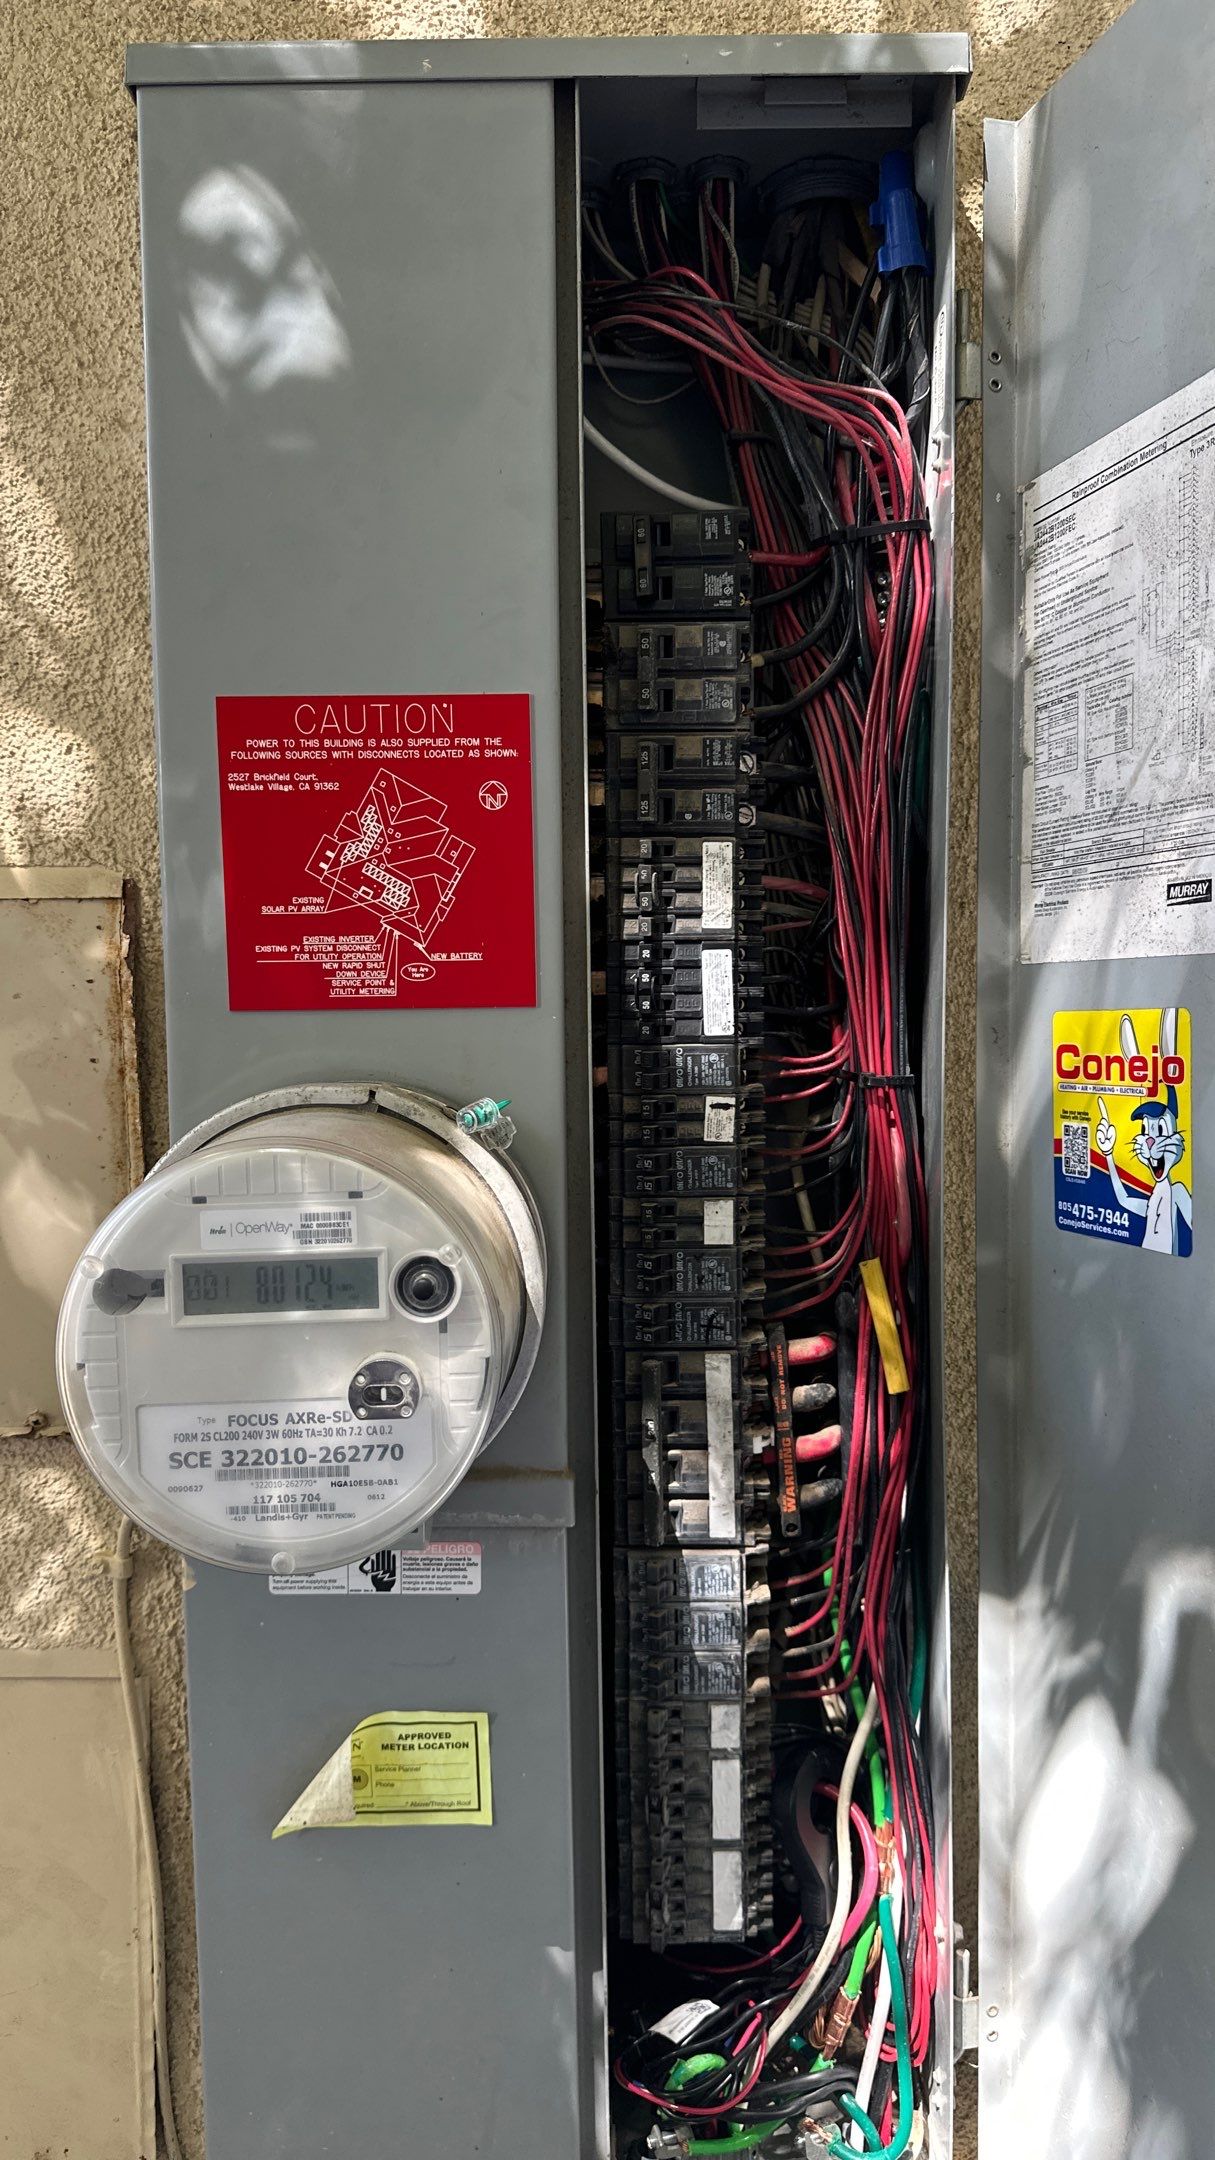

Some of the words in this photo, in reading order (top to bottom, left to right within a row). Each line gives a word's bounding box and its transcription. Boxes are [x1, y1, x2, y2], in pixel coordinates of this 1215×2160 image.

[1190, 444, 1205, 458] Type
[1072, 478, 1100, 500] Rainproof
[1100, 457, 1138, 484] Combination
[1140, 441, 1168, 462] Metering
[642, 638, 650, 649] 50
[642, 688, 650, 700] 50
[294, 703, 454, 734] CAUTION
[246, 739, 278, 748] POWER
[283, 739, 295, 748] TO
[299, 738, 320, 748] THIS
[324, 738, 364, 748] BUILDING
[368, 738, 376, 747] IS
[380, 738, 403, 747] ALSO
[407, 738, 450, 746] SUPPLIED
[454, 737, 480, 746] FROM
[484, 737, 502, 746] THE
[230, 750, 281, 760] FOLLOWING
[284, 750, 328, 760] SOURCES
[331, 750, 354, 760] WITH
[358, 750, 420, 759] DISCONNECTS
[424, 749, 464, 758] LOCATED
[468, 749, 480, 758] AS
[484, 748, 519, 758] SHOWN:
[228, 773, 250, 782] 2527
[254, 773, 290, 781] Brickfield
[228, 784, 264, 792] Westlake
[298, 782, 310, 790] CA
[314, 782, 340, 790] 91362
[640, 842, 648, 854] 20
[1170, 882, 1208, 898] MURRAY
[642, 896, 649, 908] 50
[641, 922, 648, 932] 20
[642, 949, 650, 959] 20
[642, 974, 650, 983] 50
[642, 1000, 650, 1010] 50
[642, 1026, 650, 1036] 20
[1056, 1044, 1185, 1098] Conejo
[644, 1105, 650, 1116] 15
[644, 1128, 650, 1140] 15
[644, 1159, 652, 1168] 15
[644, 1181, 652, 1191] 15
[646, 1209, 652, 1218] 15
[1058, 1200, 1072, 1212] 805
[1072, 1204, 1130, 1228] 475-7944
[210, 1226, 226, 1235] Itron
[236, 1221, 290, 1235] OpenWay
[1058, 1216, 1130, 1238] ConejoServices.com
[644, 1260, 652, 1270] 15
[643, 1310, 652, 1320] 15
[644, 1332, 652, 1342] 15
[776, 1344, 784, 1376] REMOVE
[780, 1399, 786, 1410] DO
[197, 1416, 216, 1426] Type
[227, 1414, 279, 1428] FOCUS
[285, 1410, 353, 1425] AXRe-SD
[173, 1432, 198, 1443] FORM
[200, 1432, 212, 1442] 2S
[213, 1431, 240, 1442] CL200
[242, 1430, 264, 1440] 240V
[266, 1430, 280, 1440] 3W
[282, 1428, 304, 1439] 60Hz
[305, 1427, 334, 1438] TA=30
[336, 1427, 347, 1436] Kh
[348, 1426, 362, 1436] 7.2
[366, 1426, 378, 1436] CA
[380, 1425, 393, 1435] 0.2
[168, 1450, 212, 1470] SCE
[221, 1444, 404, 1468] 322010-262770
[782, 1437, 798, 1513] WARNING
[253, 1495, 274, 1504] 117
[277, 1494, 297, 1504] 105
[300, 1493, 322, 1502] 704
[256, 1512, 308, 1522] Landis+Gyr
[426, 1544, 474, 1554] PELIGRO
[398, 1732, 452, 1740] APPROVED
[381, 1743, 415, 1752] METER
[418, 1741, 470, 1750] LOCATION
